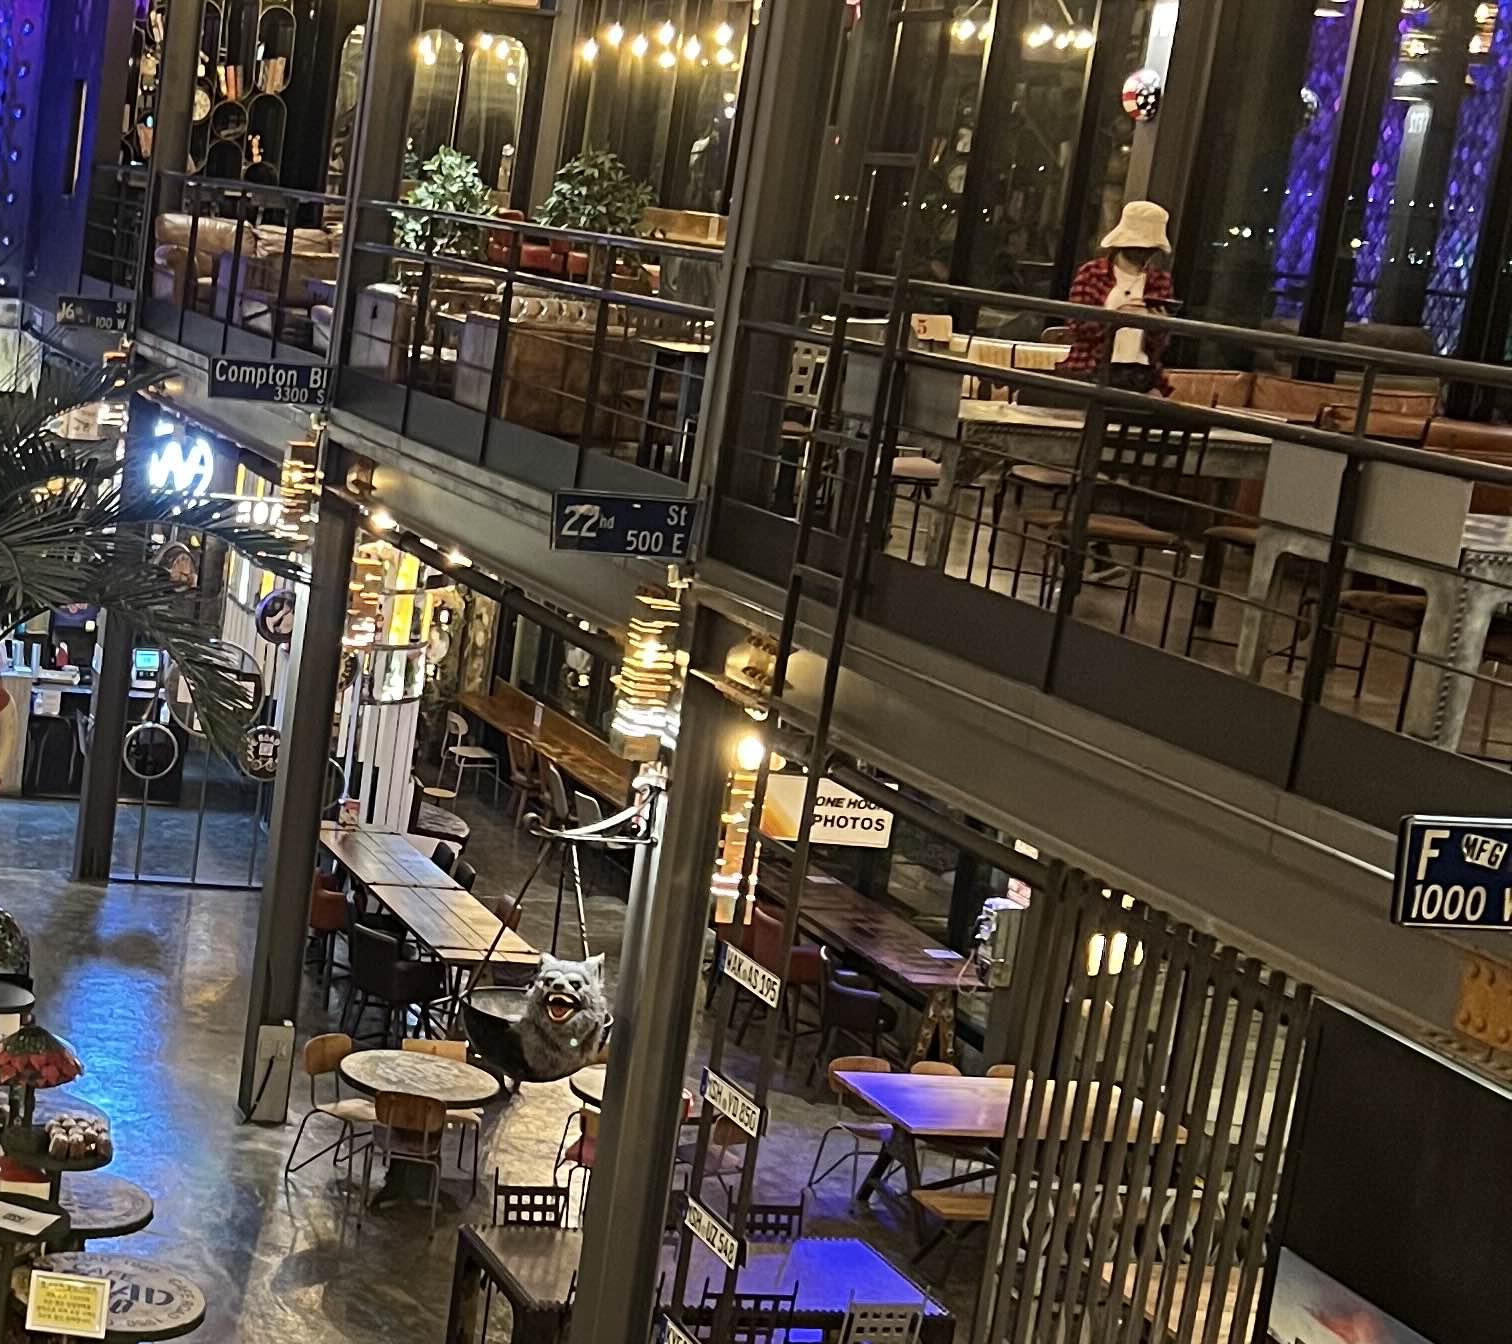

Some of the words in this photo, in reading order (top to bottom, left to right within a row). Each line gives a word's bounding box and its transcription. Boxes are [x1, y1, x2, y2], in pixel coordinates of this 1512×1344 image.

[95, 317, 113, 329] 100
[117, 318, 126, 329] W
[916, 318, 928, 335] 5
[215, 360, 298, 389] Compton
[309, 366, 328, 389] Bl
[273, 387, 309, 404] 3300
[316, 388, 326, 404] S
[560, 504, 615, 537] 22nd
[666, 504, 688, 526] St
[625, 529, 664, 553] 500
[671, 533, 685, 554] E
[816, 795, 845, 809] ONE
[812, 813, 886, 832] PHOTOS
[1416, 829, 1451, 881] F
[1411, 882, 1487, 922] 1000
[759, 973, 779, 1003] 195
